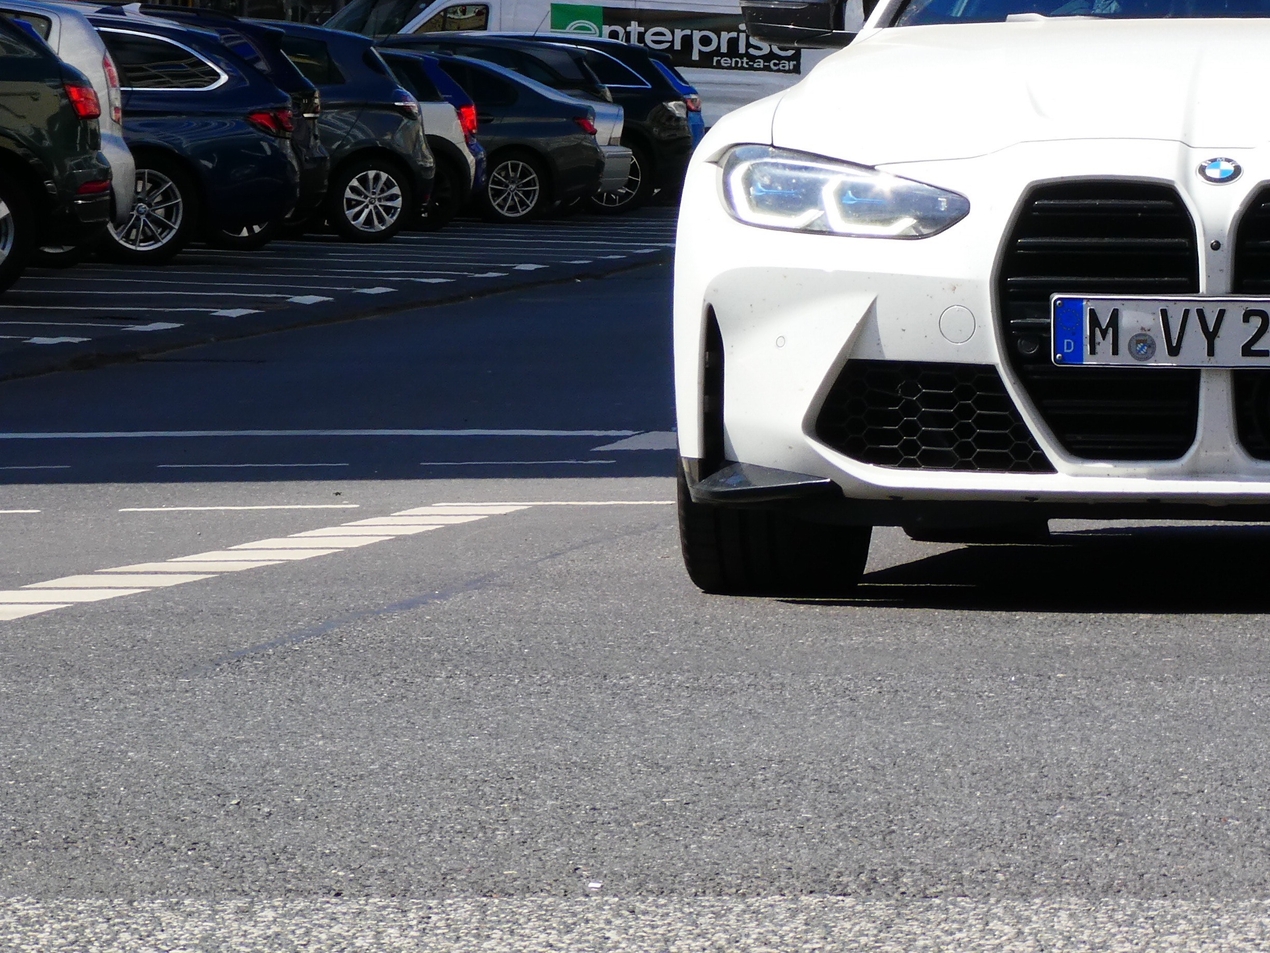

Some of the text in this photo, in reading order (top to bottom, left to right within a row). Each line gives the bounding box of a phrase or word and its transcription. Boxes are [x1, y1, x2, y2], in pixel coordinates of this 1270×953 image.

[713, 55, 797, 71] rent-a-car
[1087, 307, 1119, 356] M
[1159, 308, 1227, 358] VY
[1063, 339, 1074, 354] D
